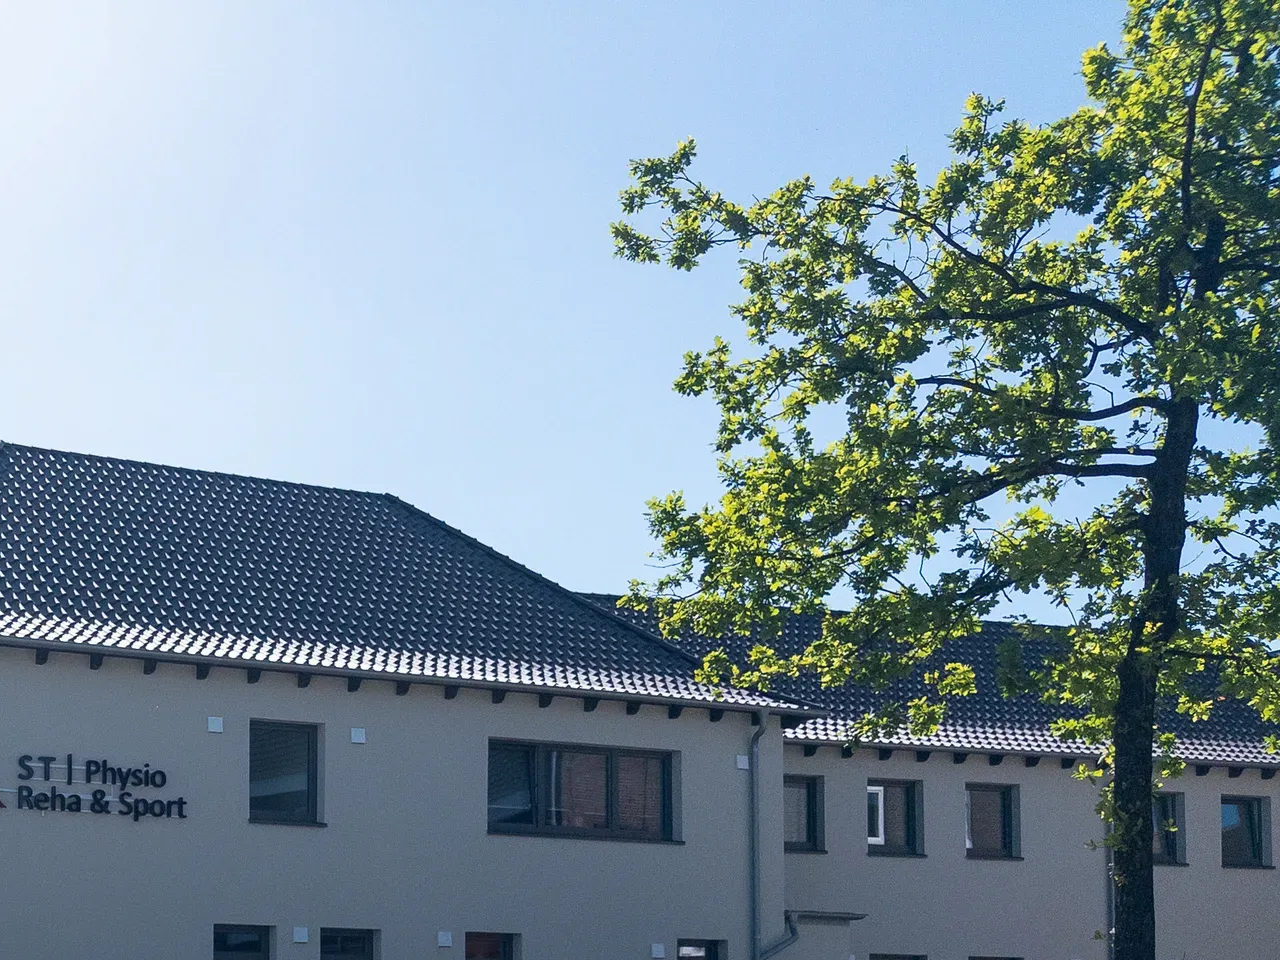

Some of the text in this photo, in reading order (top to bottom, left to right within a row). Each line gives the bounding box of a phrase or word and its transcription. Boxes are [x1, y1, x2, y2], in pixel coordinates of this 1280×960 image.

[85, 760, 167, 791] Physio
[18, 786, 187, 822] Reha & Sport
